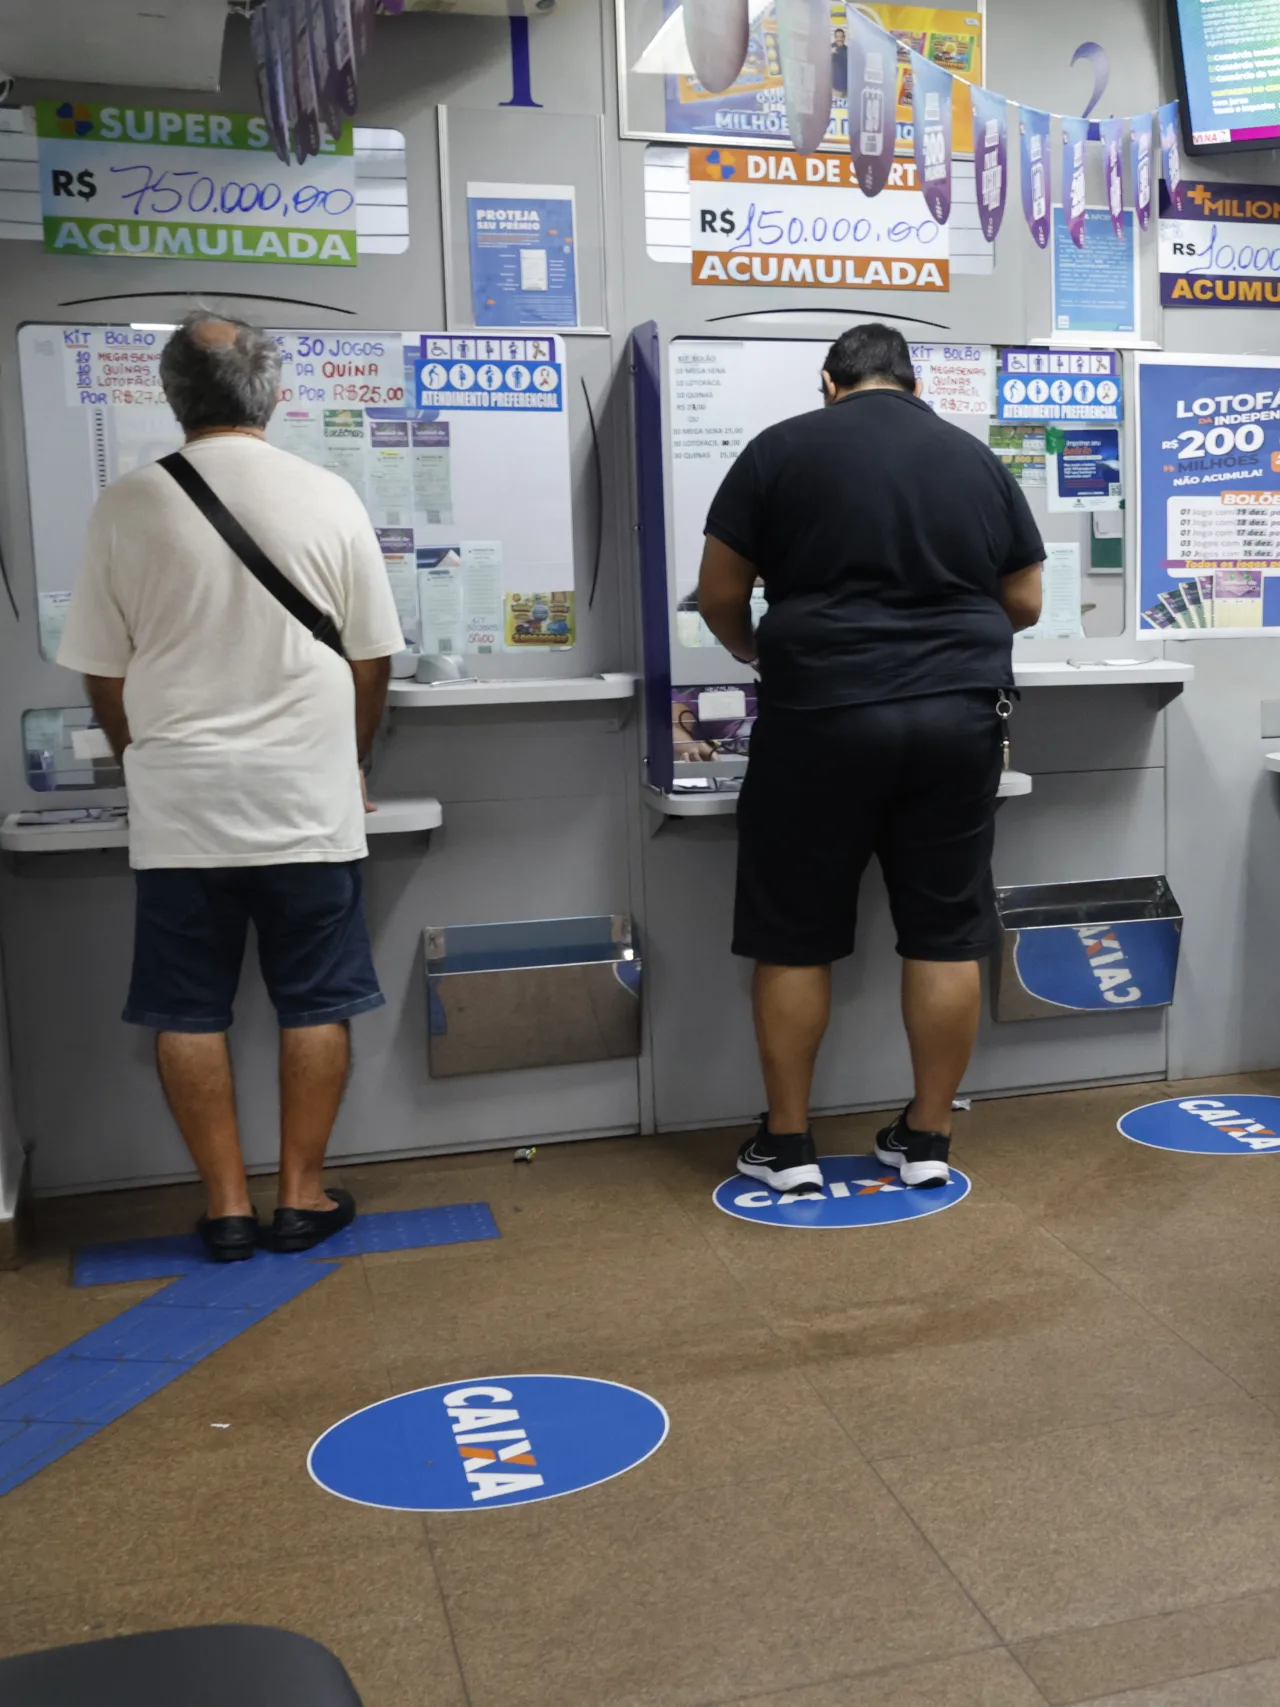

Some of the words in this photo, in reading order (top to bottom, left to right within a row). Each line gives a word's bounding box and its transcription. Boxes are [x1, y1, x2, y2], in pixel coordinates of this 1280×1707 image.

[100, 107, 234, 147] SUPER
[714, 109, 794, 131] MILHÕE
[747, 155, 790, 181] DIA
[814, 159, 841, 183] DE
[52, 168, 97, 202] R$
[476, 209, 540, 222] PROTEJA
[699, 209, 736, 237] R$
[54, 221, 351, 262] ACUMULADA
[1172, 242, 1197, 260] R$
[697, 255, 945, 287] ACUMULADA
[296, 336, 325, 358] 30
[328, 339, 385, 357] JOGOS
[295, 362, 315, 376] DA
[322, 360, 379, 379] QUINA
[80, 390, 108, 405] POR
[298, 384, 326, 401] POR
[421, 390, 490, 407] ATENDIMENTO
[490, 392, 559, 409] PREFERENCIAL
[1198, 416, 1213, 425] DA
[1161, 439, 1180, 450] R$
[1177, 423, 1265, 460] 200
[1178, 453, 1259, 473] MILHÕES
[1173, 475, 1200, 487] NÃO
[1202, 468, 1264, 484] ACUMULA!
[1186, 560, 1219, 568] Todos
[443, 1386, 545, 1502] CAIXA
